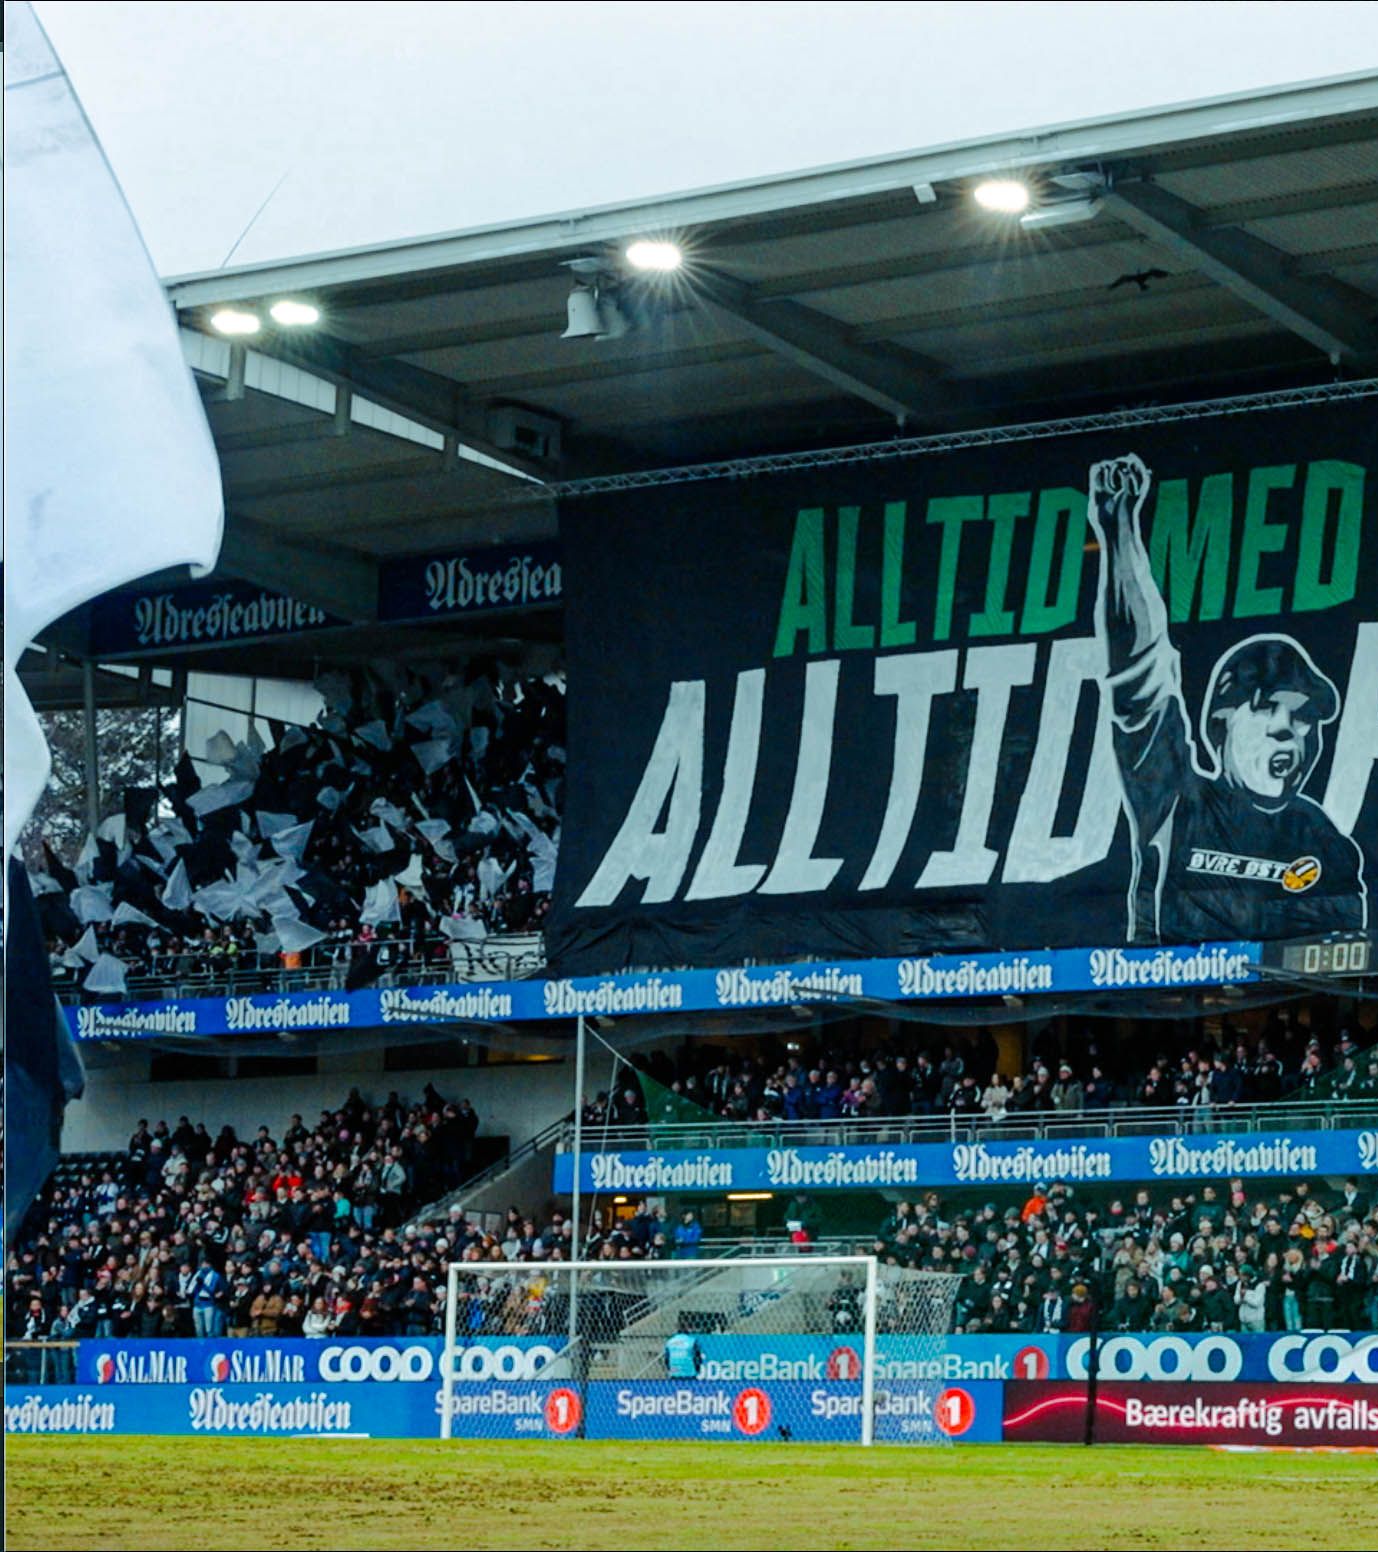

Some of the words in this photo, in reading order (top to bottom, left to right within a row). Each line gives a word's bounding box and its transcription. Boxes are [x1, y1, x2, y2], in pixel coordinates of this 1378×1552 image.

[773, 486, 1092, 657] ALLTID
[1146, 459, 1366, 623] MED
[575, 636, 1126, 907] ALLTID
[897, 957, 1053, 997] Adresseavisen
[1305, 942, 1366, 973] 0:00
[225, 997, 350, 1028] Adresseavisen
[544, 980, 683, 1014] Adresseavisen
[590, 1152, 733, 1190] Adresseavisen
[766, 1147, 918, 1187] Adresseavisen
[952, 1142, 1112, 1182] Adresseavisen
[1149, 1137, 1317, 1178] Adresseavisen
[189, 1387, 351, 1431] Adresseavisen
[617, 1390, 730, 1418] SpareBank
[1126, 1398, 1283, 1435] Bærekraftig
[701, 1419, 731, 1432] SMN
